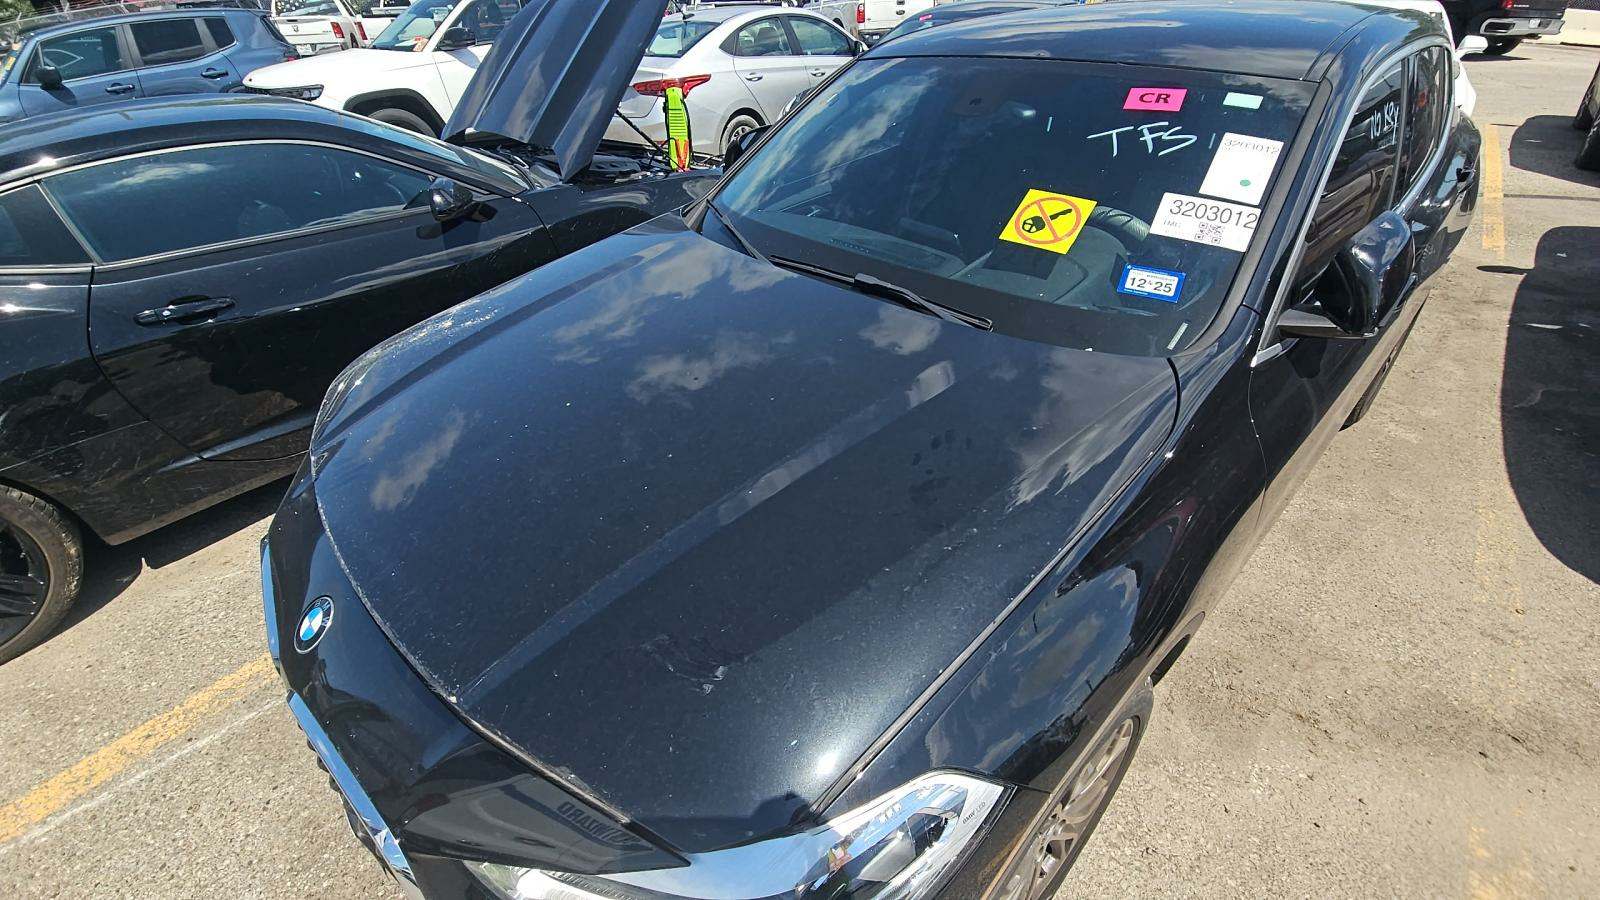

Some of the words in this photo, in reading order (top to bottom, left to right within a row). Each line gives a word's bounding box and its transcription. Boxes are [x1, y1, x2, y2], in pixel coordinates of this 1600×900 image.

[1138, 92, 1171, 103] CR
[1170, 199, 1258, 229] 3203012
[1130, 277, 1147, 288] 12
[1153, 281, 1173, 293] 25
